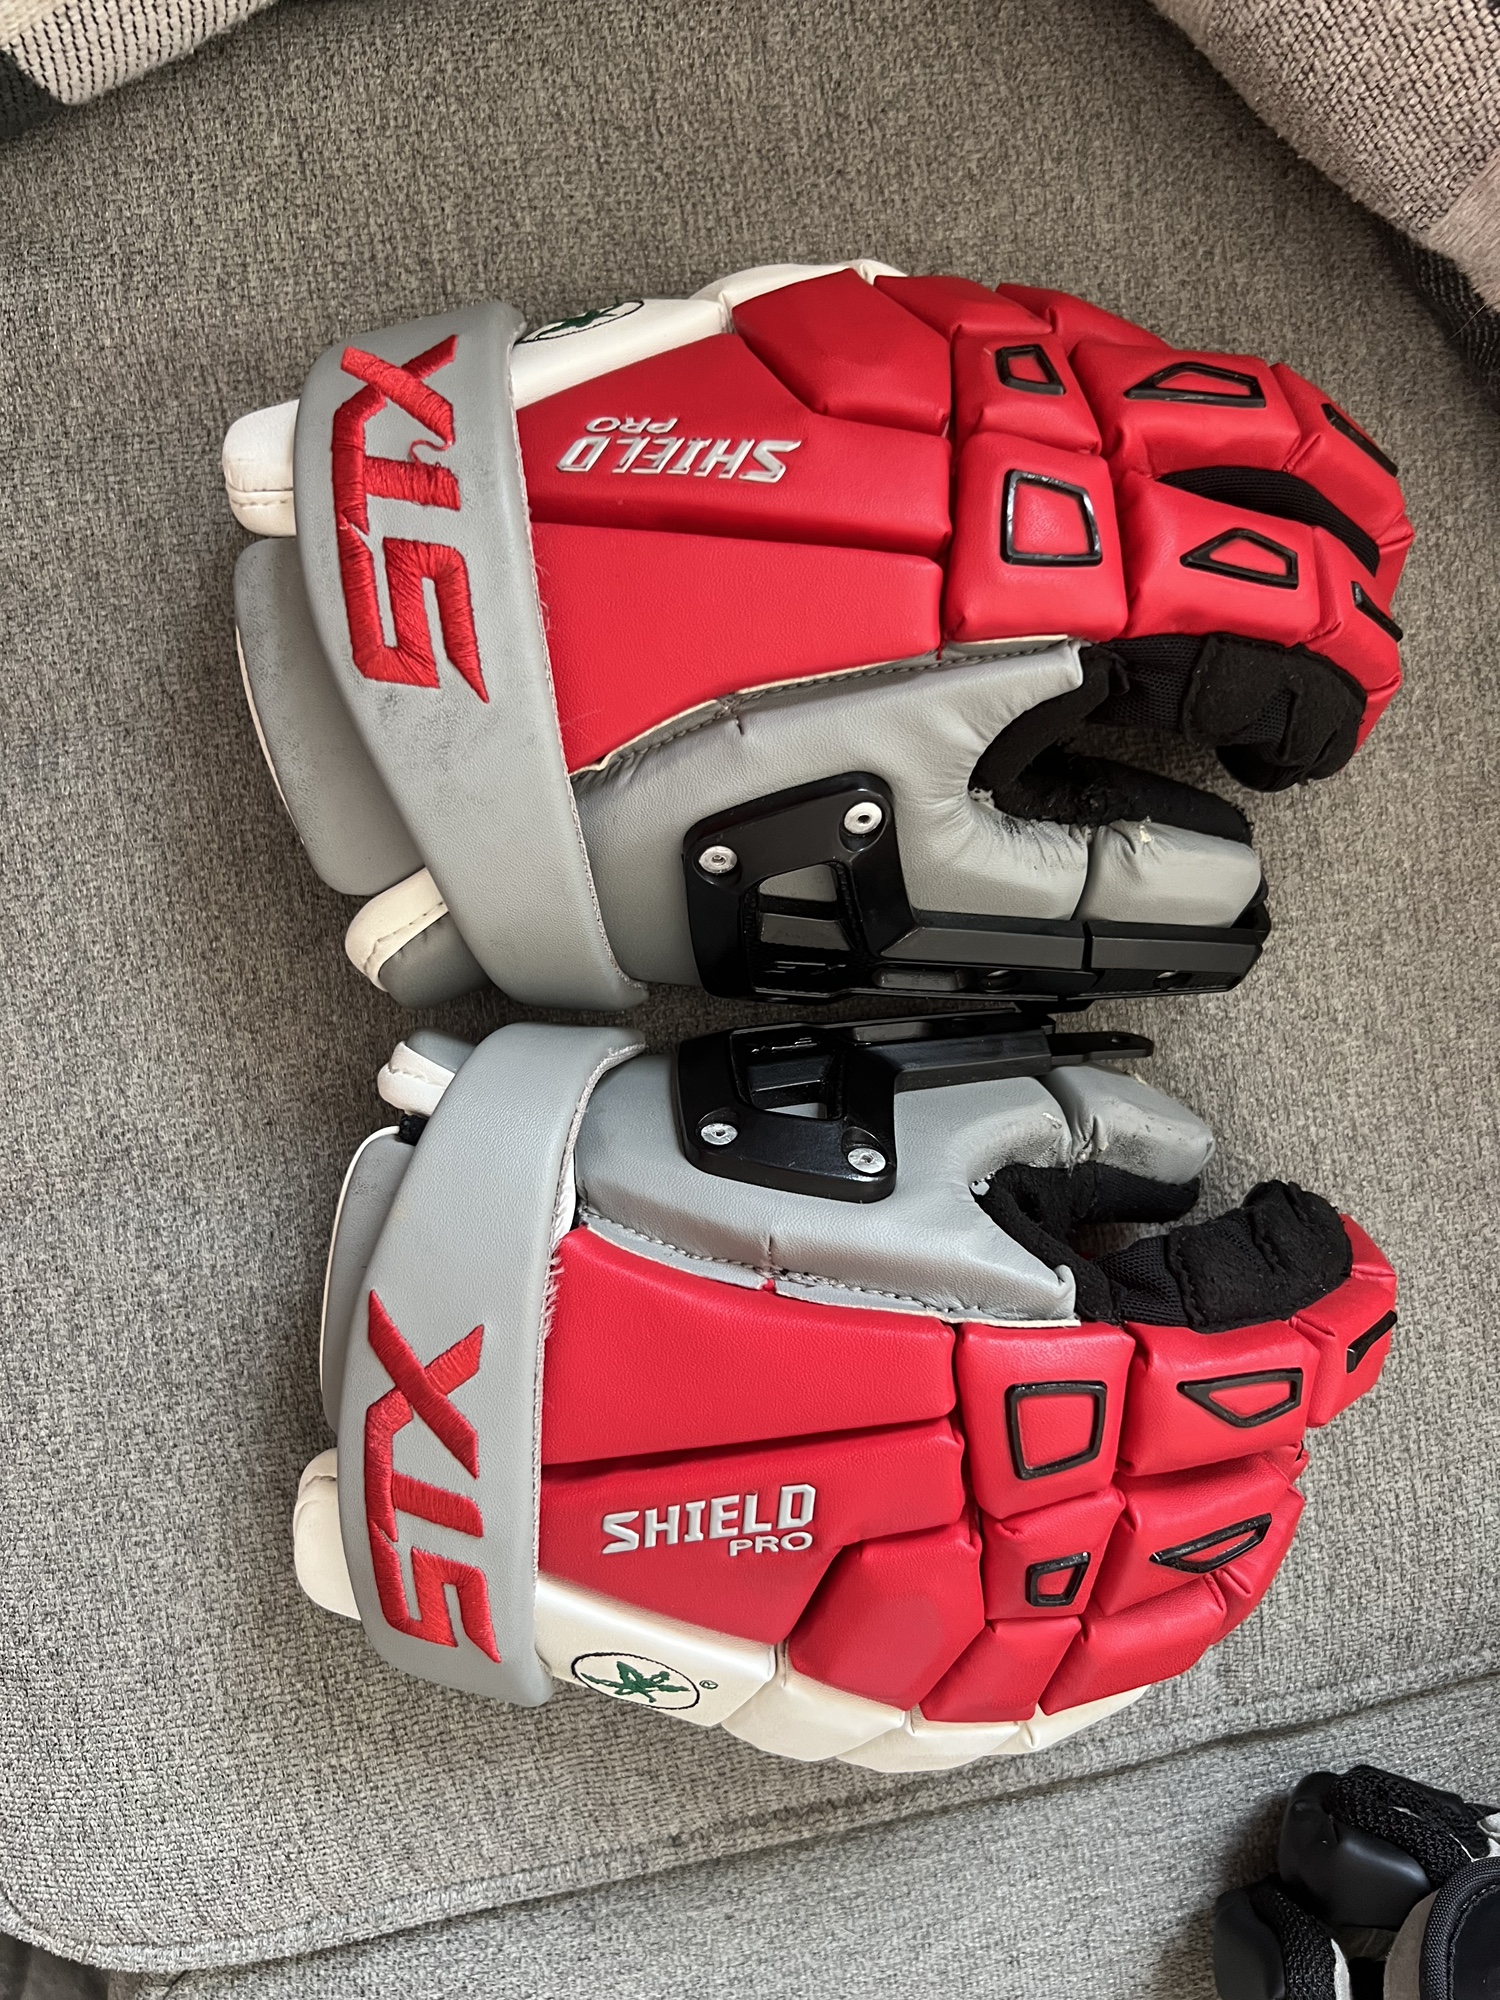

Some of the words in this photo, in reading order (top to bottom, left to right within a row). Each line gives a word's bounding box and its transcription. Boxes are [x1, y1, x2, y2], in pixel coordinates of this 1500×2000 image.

[585, 417, 678, 434] PRO
[556, 436, 801, 483] SHIELD
[331, 334, 489, 703] STX
[365, 1289, 501, 1663] STX
[602, 1483, 816, 1554] SHIELD
[729, 1531, 813, 1557] PRO
